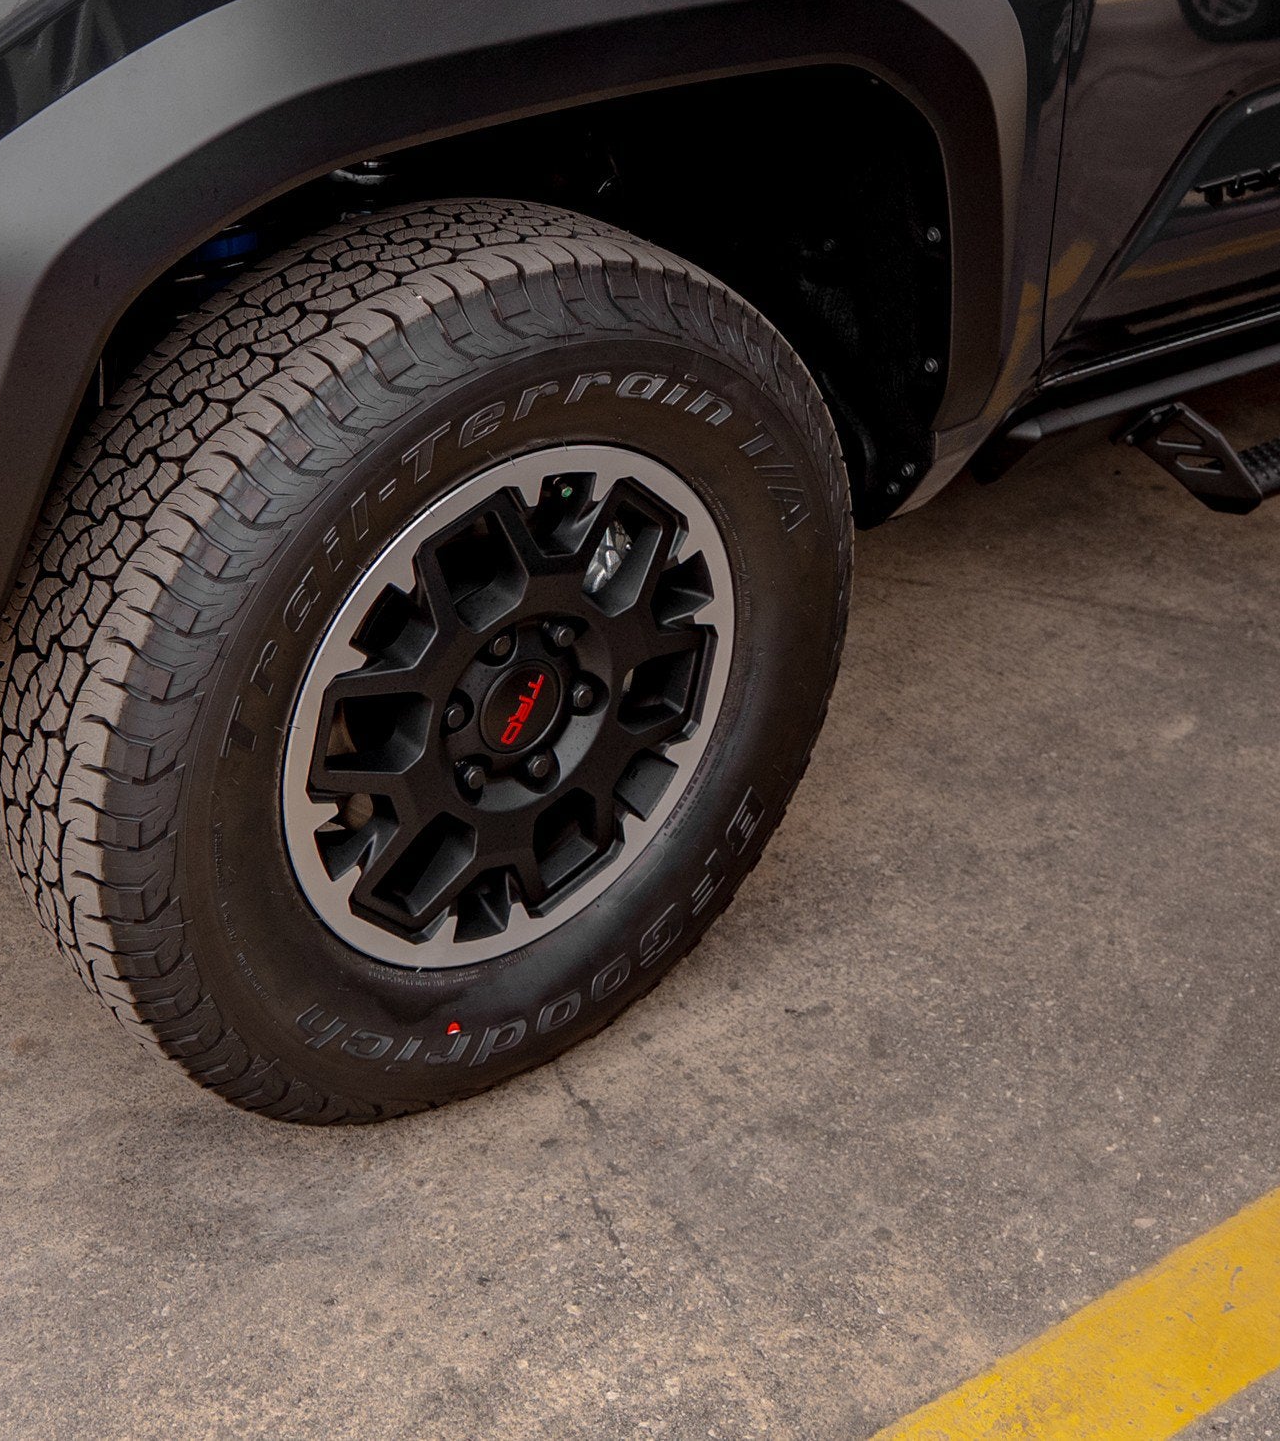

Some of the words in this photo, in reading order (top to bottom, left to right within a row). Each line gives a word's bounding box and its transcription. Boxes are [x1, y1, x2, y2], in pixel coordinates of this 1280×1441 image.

[220, 370, 737, 758] Trail-Terrain
[738, 417, 812, 534] T/A
[501, 674, 545, 745] TRD
